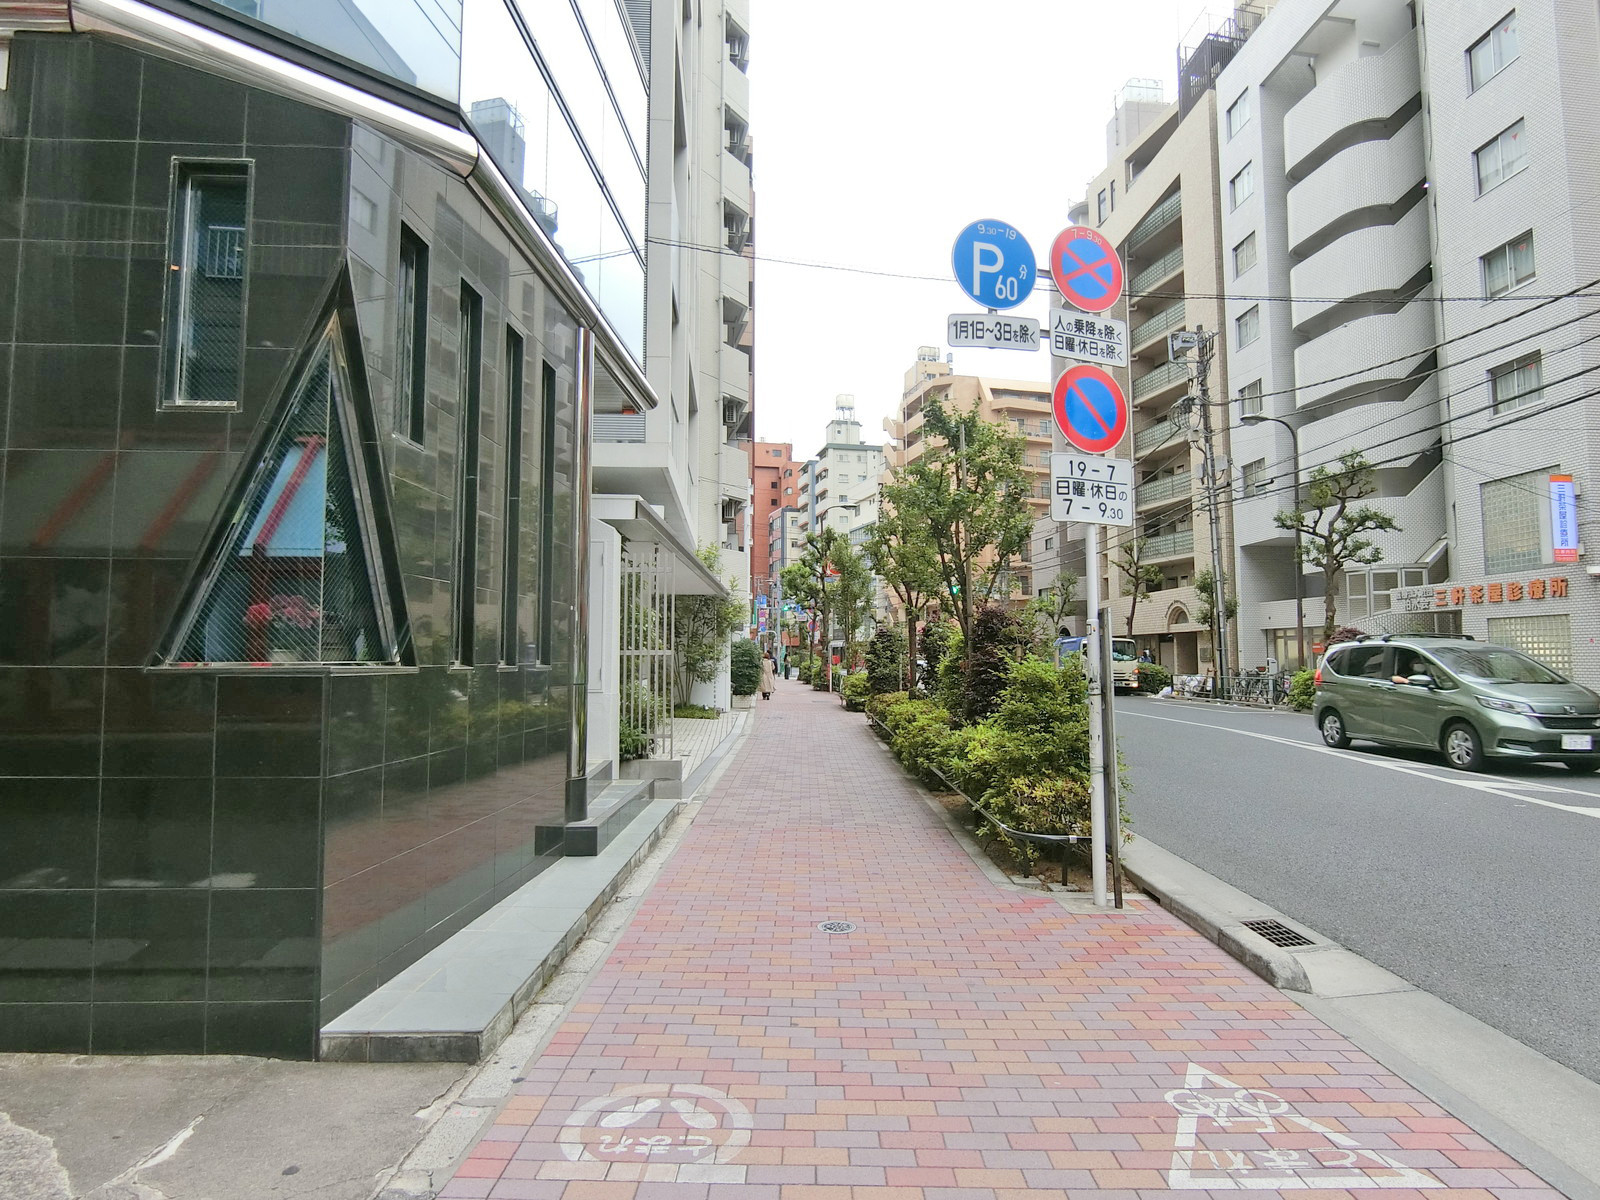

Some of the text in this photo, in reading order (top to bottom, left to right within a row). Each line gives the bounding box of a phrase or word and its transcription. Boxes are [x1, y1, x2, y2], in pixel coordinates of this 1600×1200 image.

[972, 240, 1005, 297] P
[1054, 314, 1123, 343] 人の乗降を除く
[1434, 576, 1569, 607] 三軒茶屋診療所
[599, 1135, 713, 1157] とまれ
[1197, 1147, 1361, 1174] とまれ
